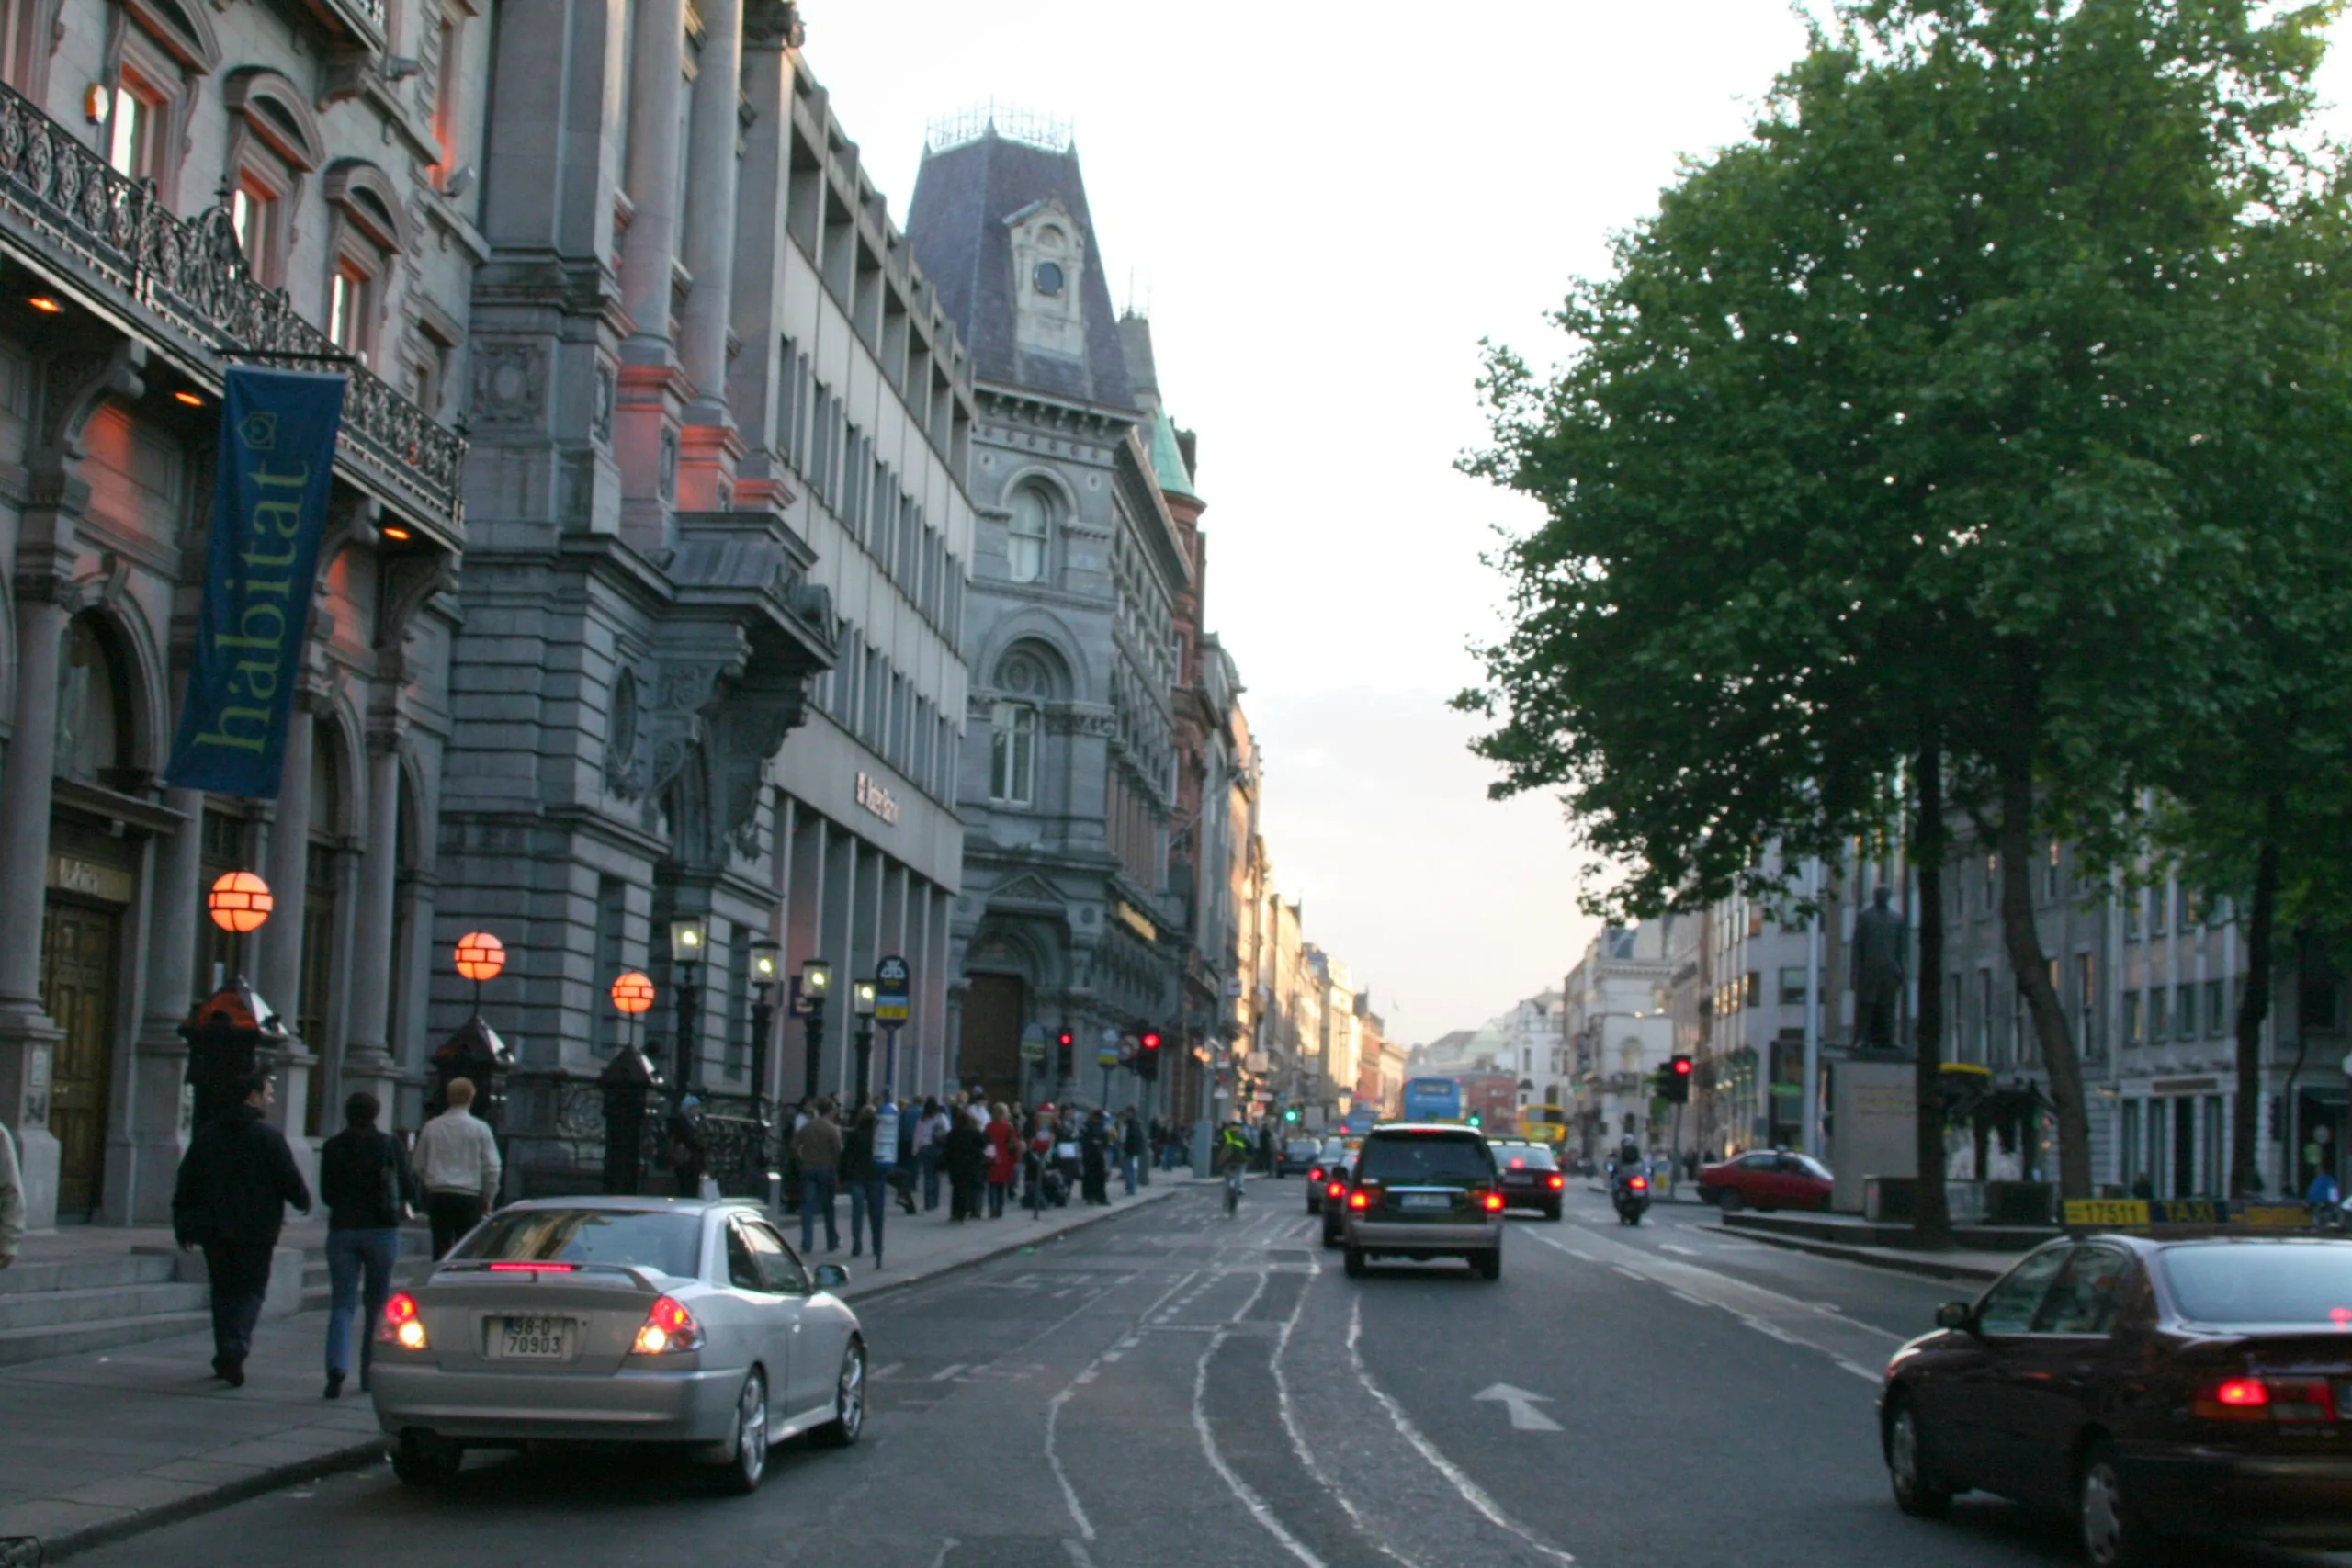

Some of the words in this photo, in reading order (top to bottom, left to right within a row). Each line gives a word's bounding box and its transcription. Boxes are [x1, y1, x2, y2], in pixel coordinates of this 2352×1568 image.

[192, 461, 310, 756] habitat
[2163, 1201, 2215, 1224] TAXI
[509, 1336, 560, 1354] 70903
